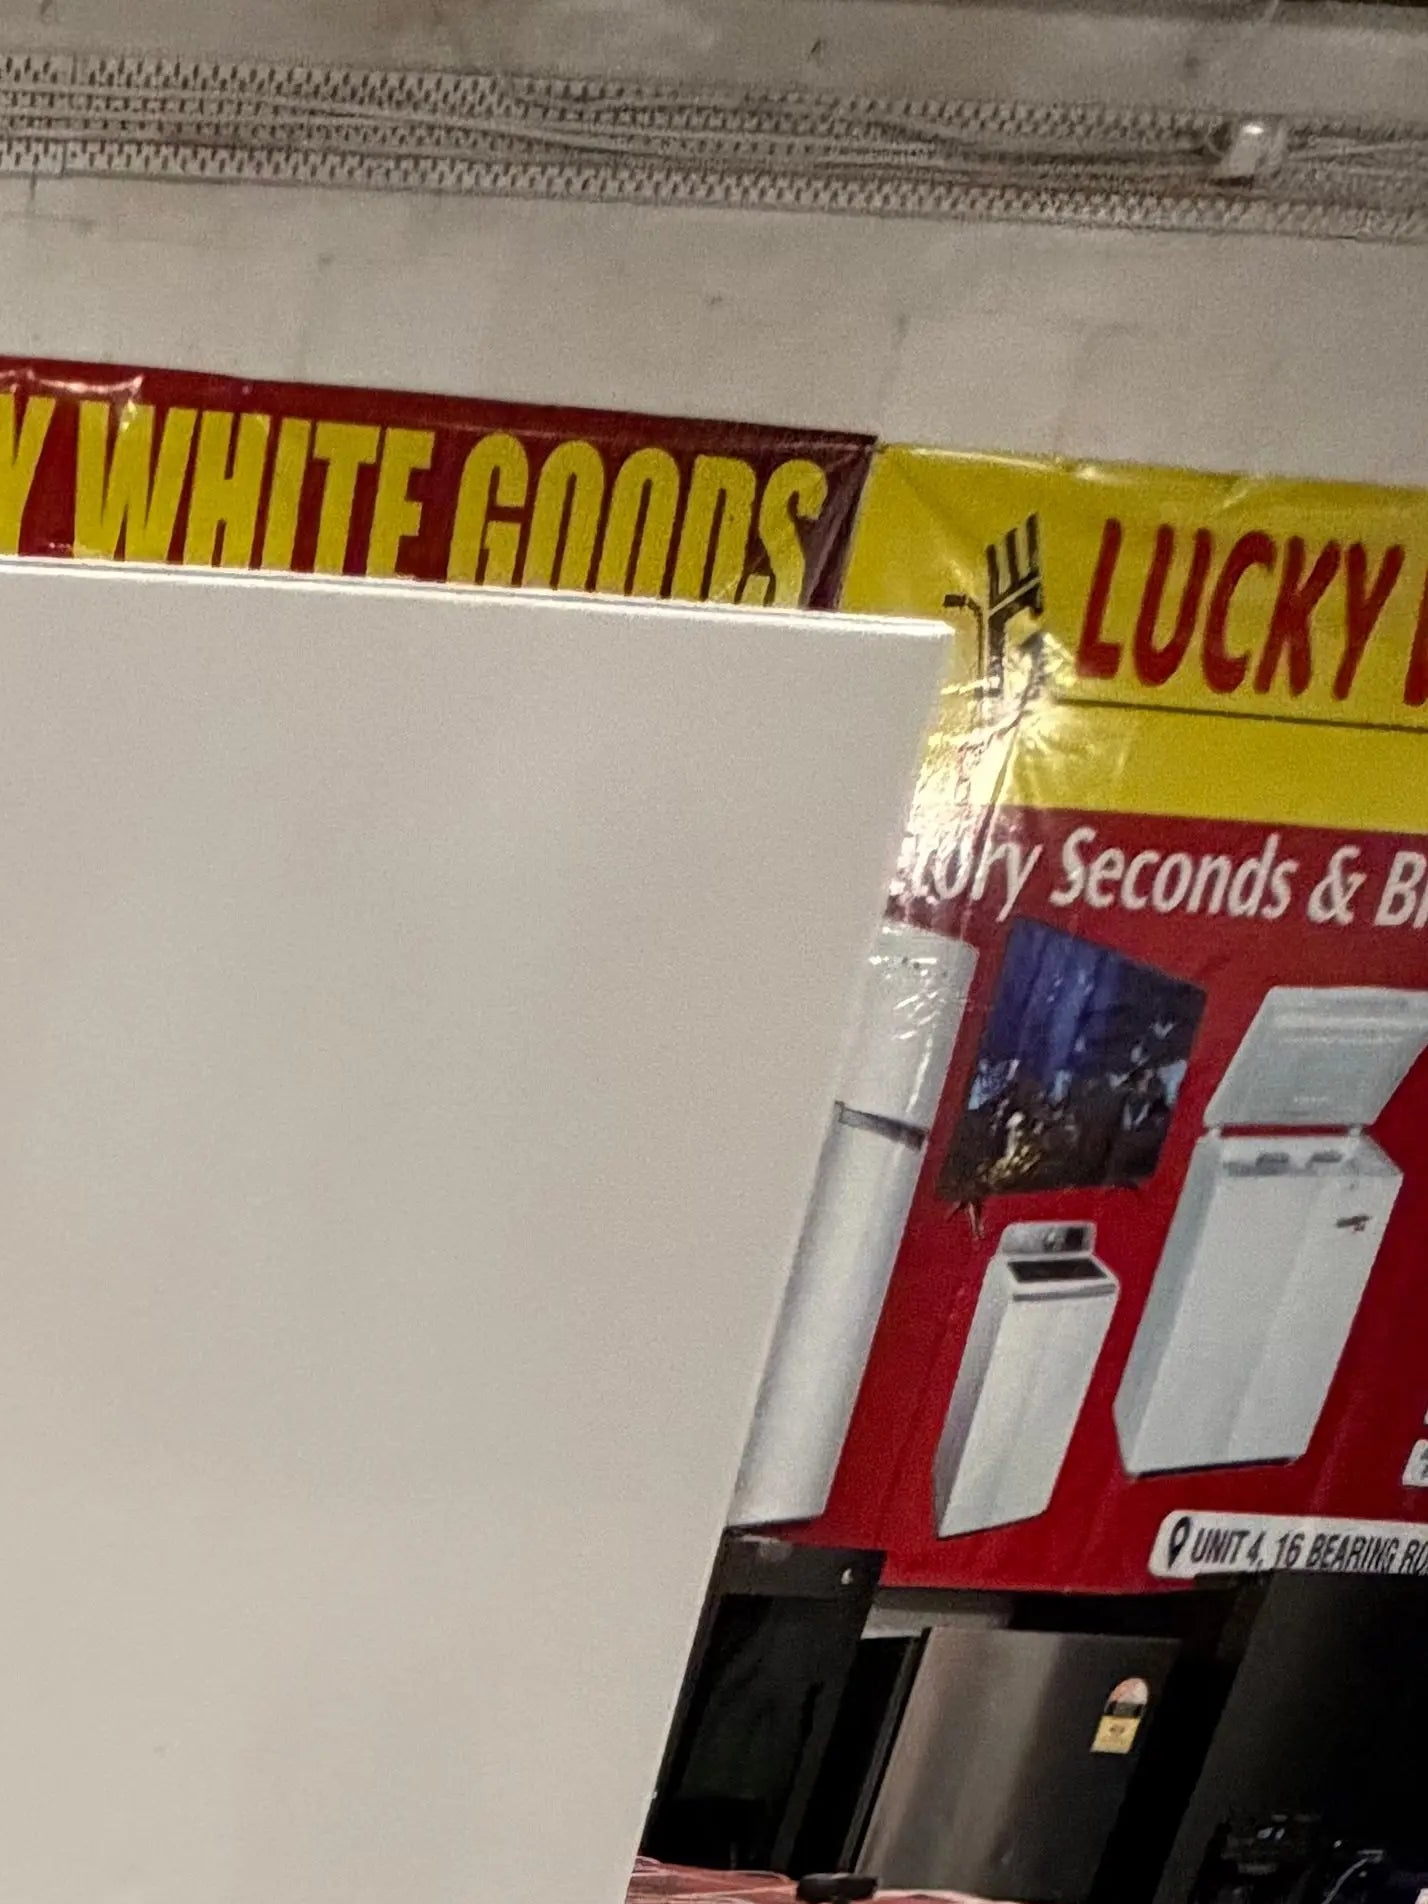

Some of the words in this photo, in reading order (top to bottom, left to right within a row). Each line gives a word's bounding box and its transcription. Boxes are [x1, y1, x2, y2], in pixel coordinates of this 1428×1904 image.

[72, 398, 437, 582] WHITE
[446, 431, 828, 609] GOODS
[1075, 516, 1406, 700] LUCKY
[1050, 826, 1299, 921] Seconds
[1307, 845, 1367, 926] &
[1190, 1527, 1251, 1565] UNIT
[1274, 1531, 1305, 1569] 16
[1306, 1533, 1400, 1573] BEARING
